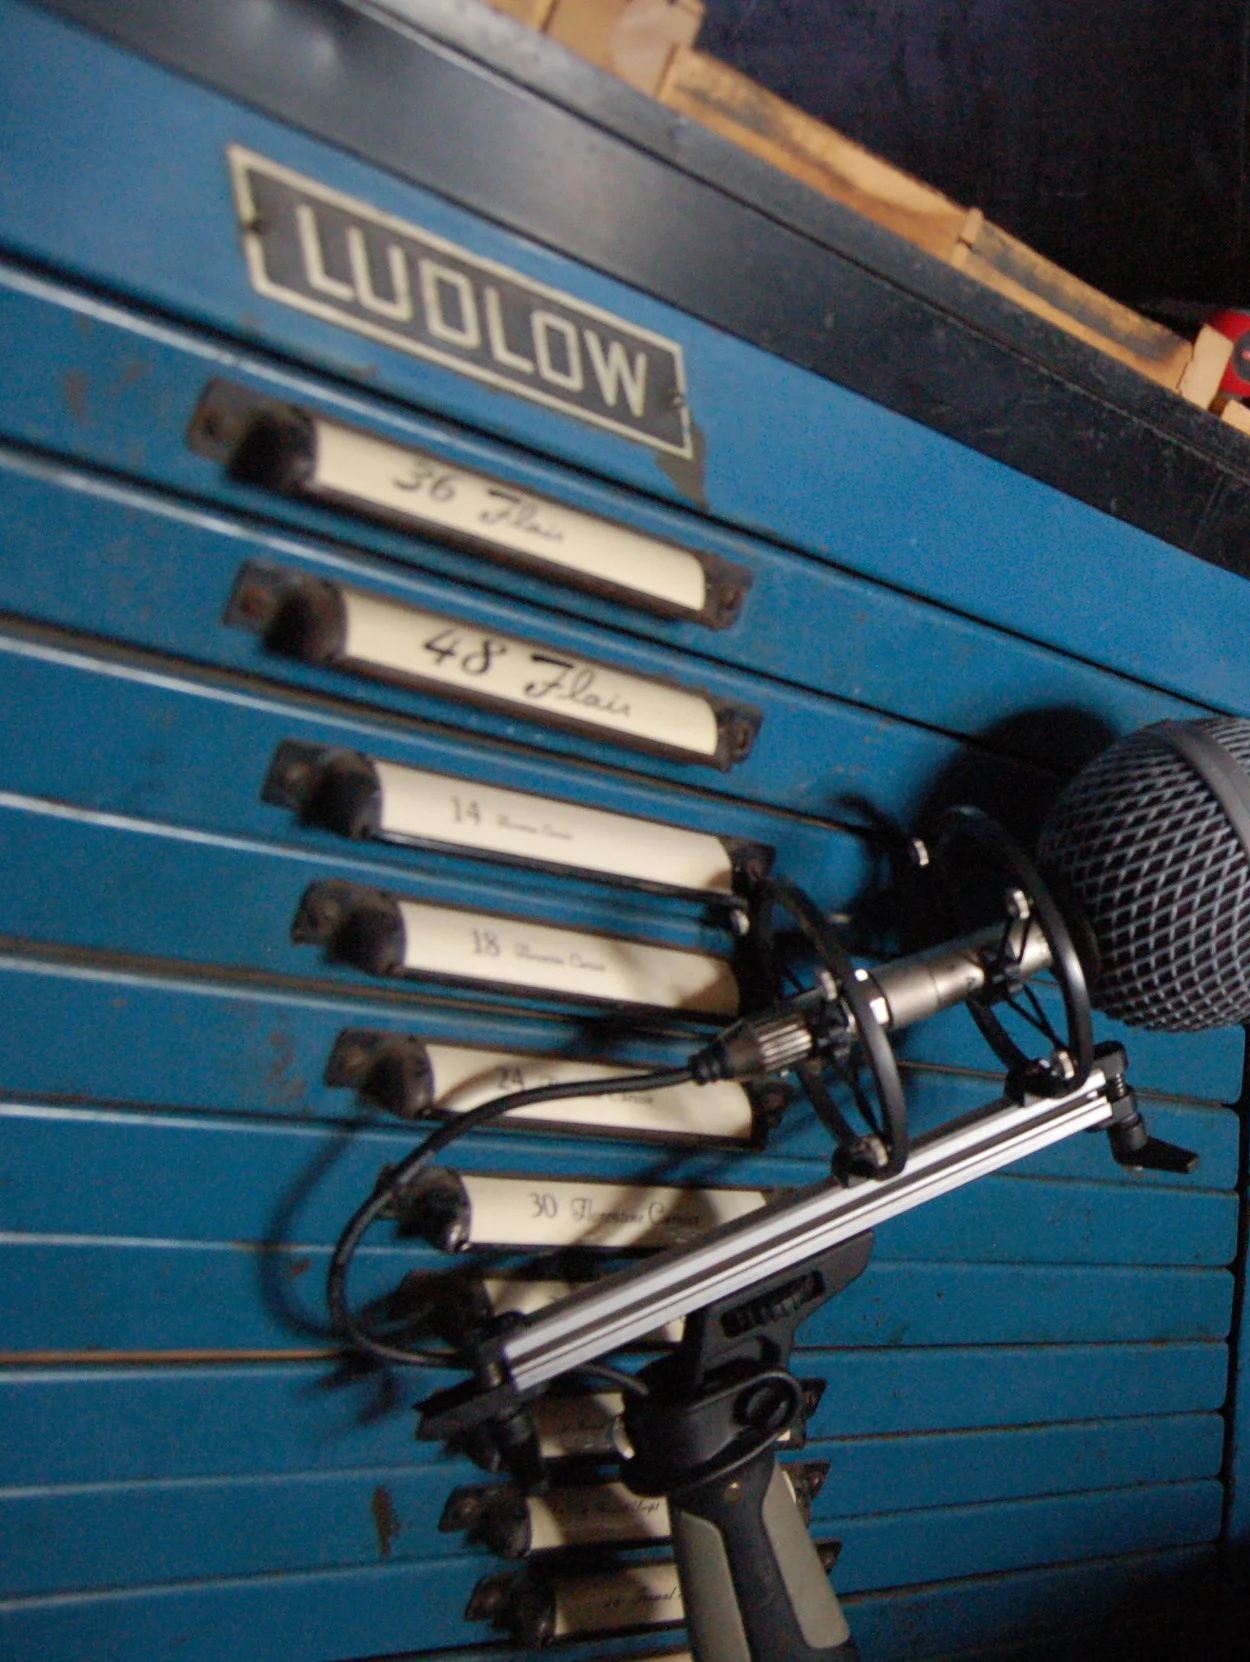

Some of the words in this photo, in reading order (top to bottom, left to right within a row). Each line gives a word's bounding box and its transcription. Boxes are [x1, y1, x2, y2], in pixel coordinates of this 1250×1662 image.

[296, 204, 648, 417] LUDLOW
[390, 454, 460, 507] 36
[479, 488, 567, 544] Flair
[421, 624, 510, 677] 48
[522, 653, 633, 719] Flair
[451, 793, 482, 826] 14
[471, 927, 502, 959] 18
[528, 1190, 559, 1220] 30
